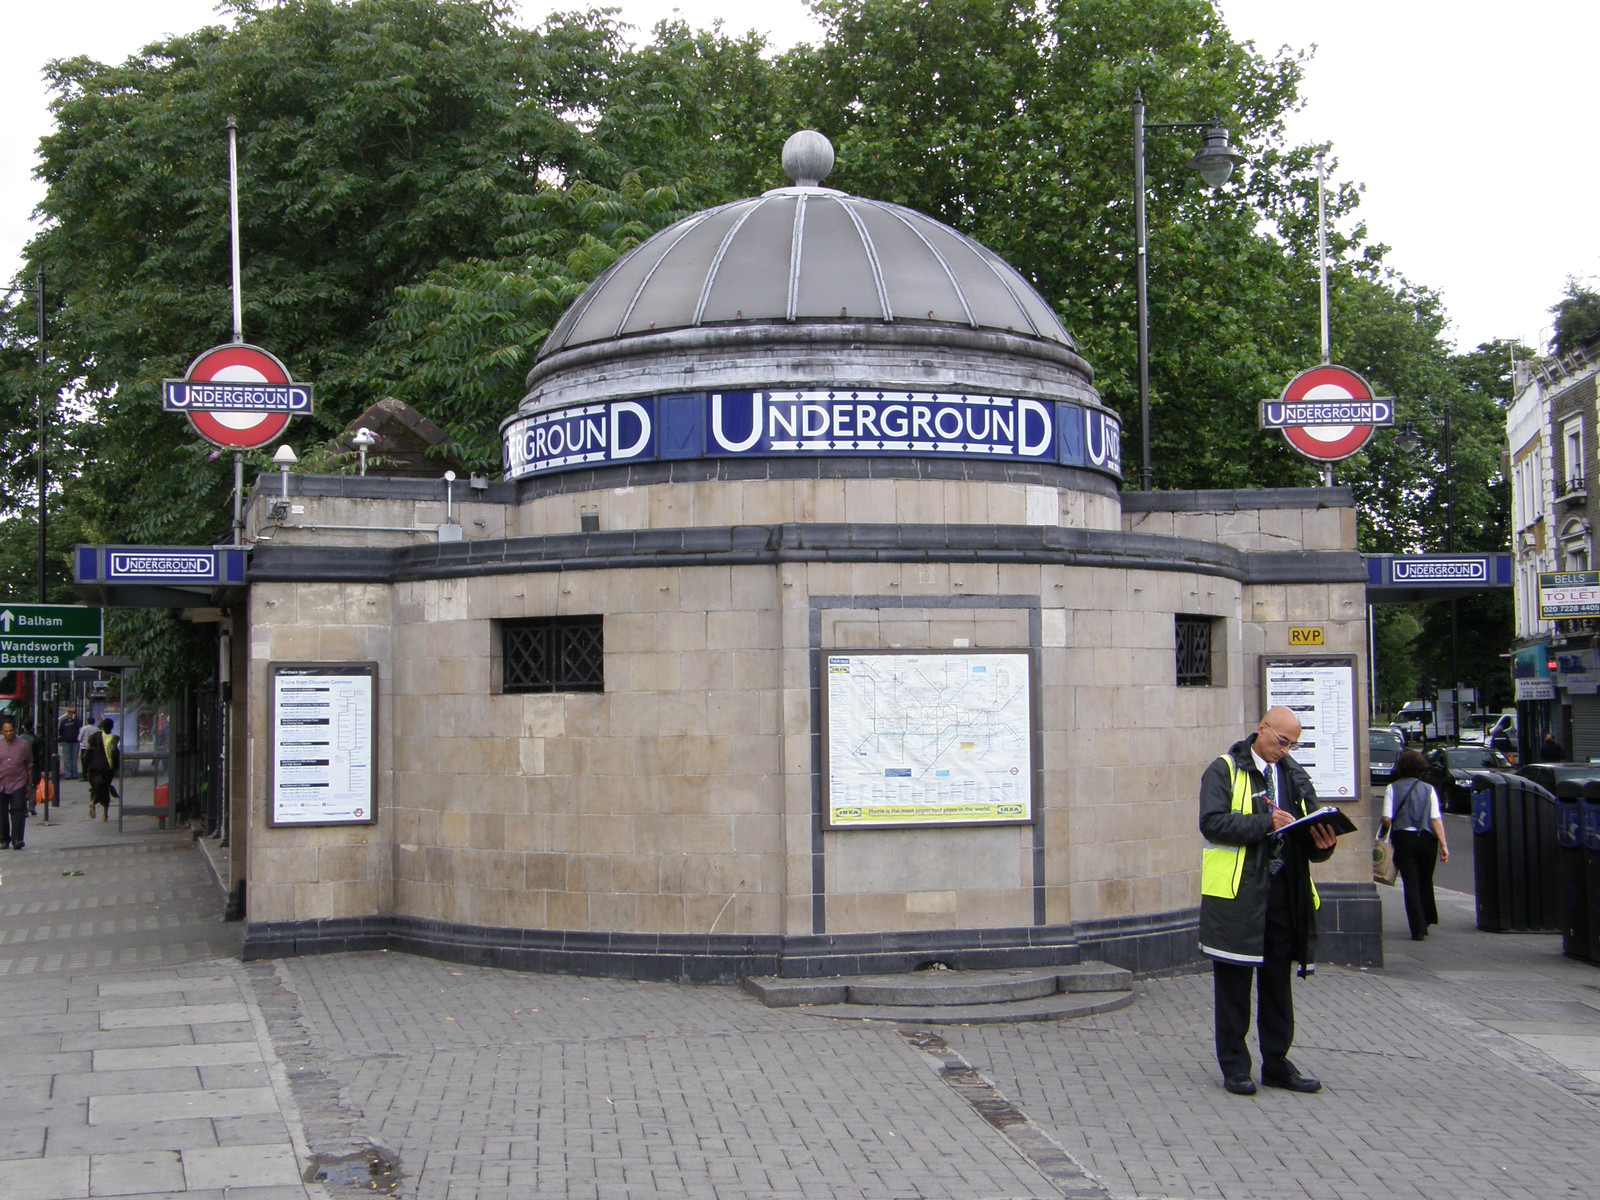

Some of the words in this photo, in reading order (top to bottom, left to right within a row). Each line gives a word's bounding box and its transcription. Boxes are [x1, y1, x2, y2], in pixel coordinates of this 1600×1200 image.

[169, 385, 308, 409] UNDERGROUND
[1267, 402, 1389, 424] UNDERGROUND
[712, 392, 1052, 456] UNDERGROUND
[115, 557, 210, 573] UNDERGROUND
[1396, 563, 1483, 578] UNDERGROUND
[1554, 573, 1585, 584] BELLS
[1544, 592, 1565, 601] TO
[1570, 591, 1598, 600] LET
[18, 615, 63, 626] Balham
[1292, 630, 1321, 642] RVP
[1, 640, 74, 651] Wandsworth
[1, 653, 59, 664] Battersea
